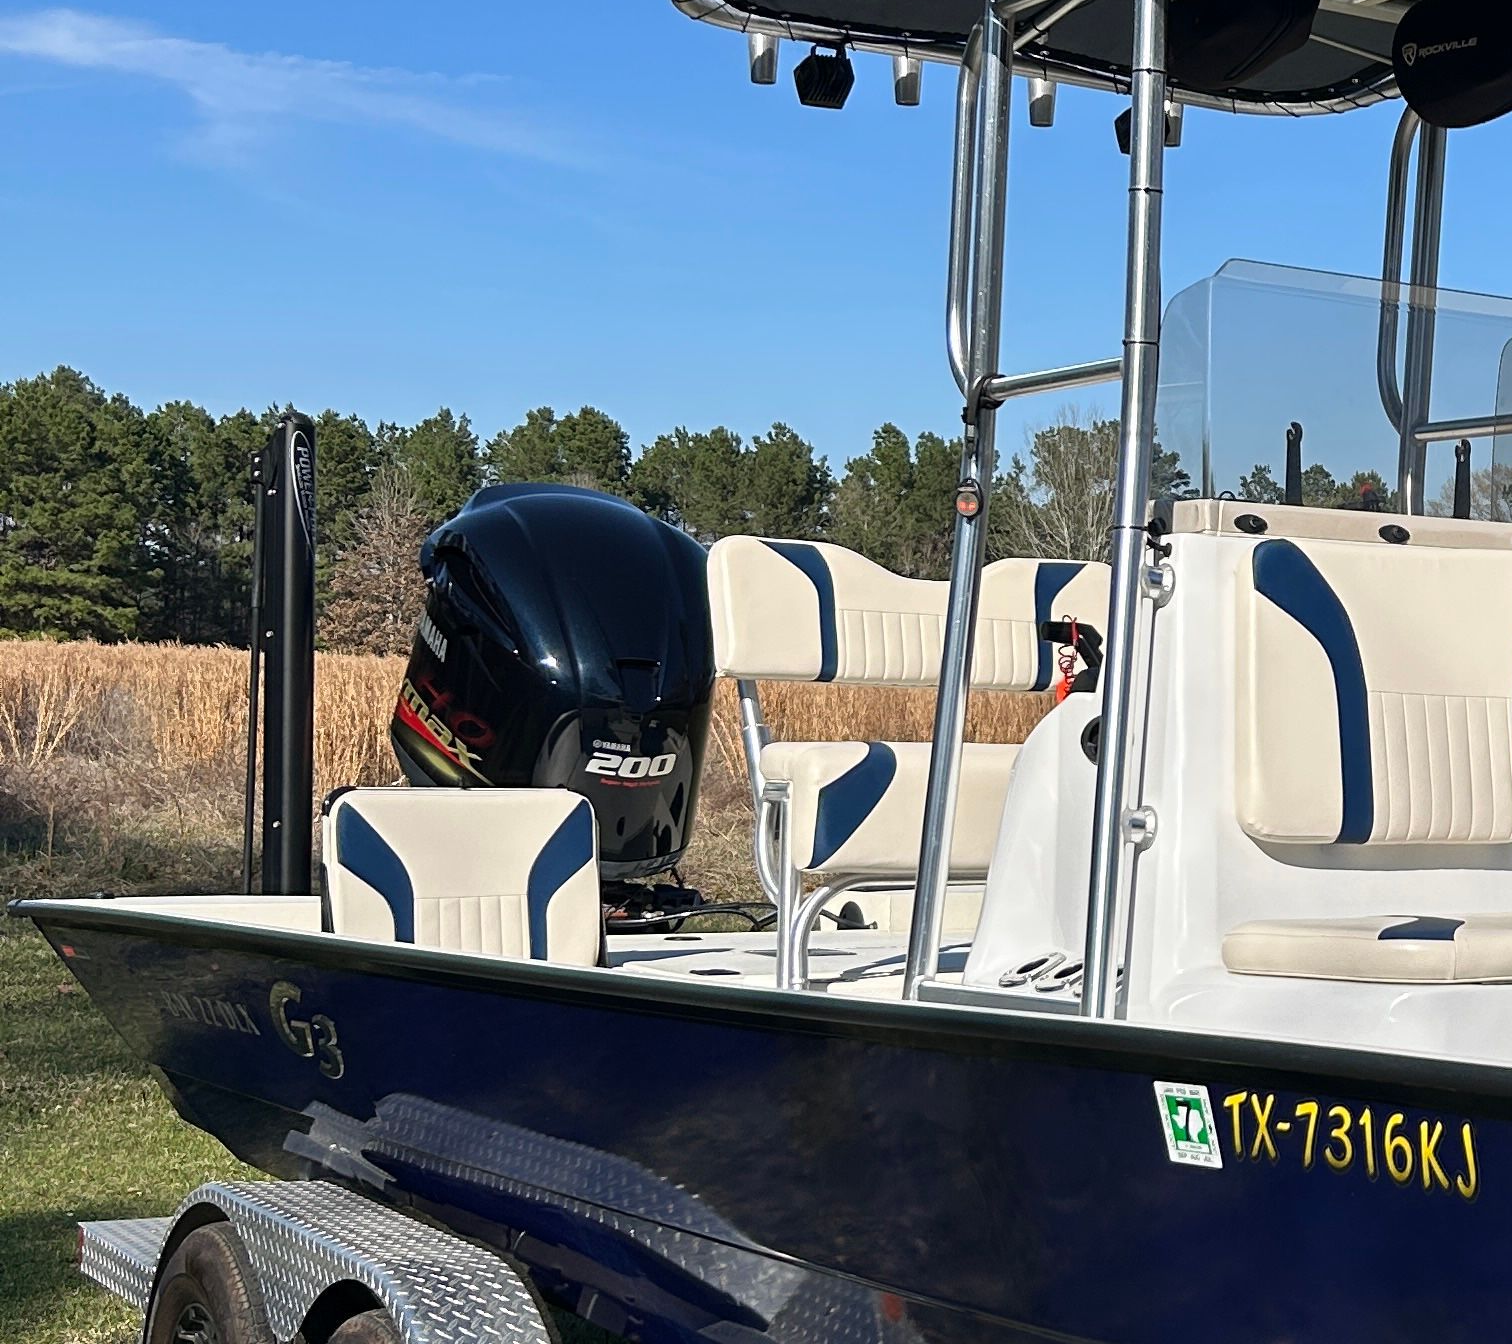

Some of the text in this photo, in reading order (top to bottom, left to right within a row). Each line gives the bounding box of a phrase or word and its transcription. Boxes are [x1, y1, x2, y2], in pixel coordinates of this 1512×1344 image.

[1418, 36, 1479, 58] ROCKVILLE
[584, 751, 678, 779] 200
[268, 979, 345, 1080] G3
